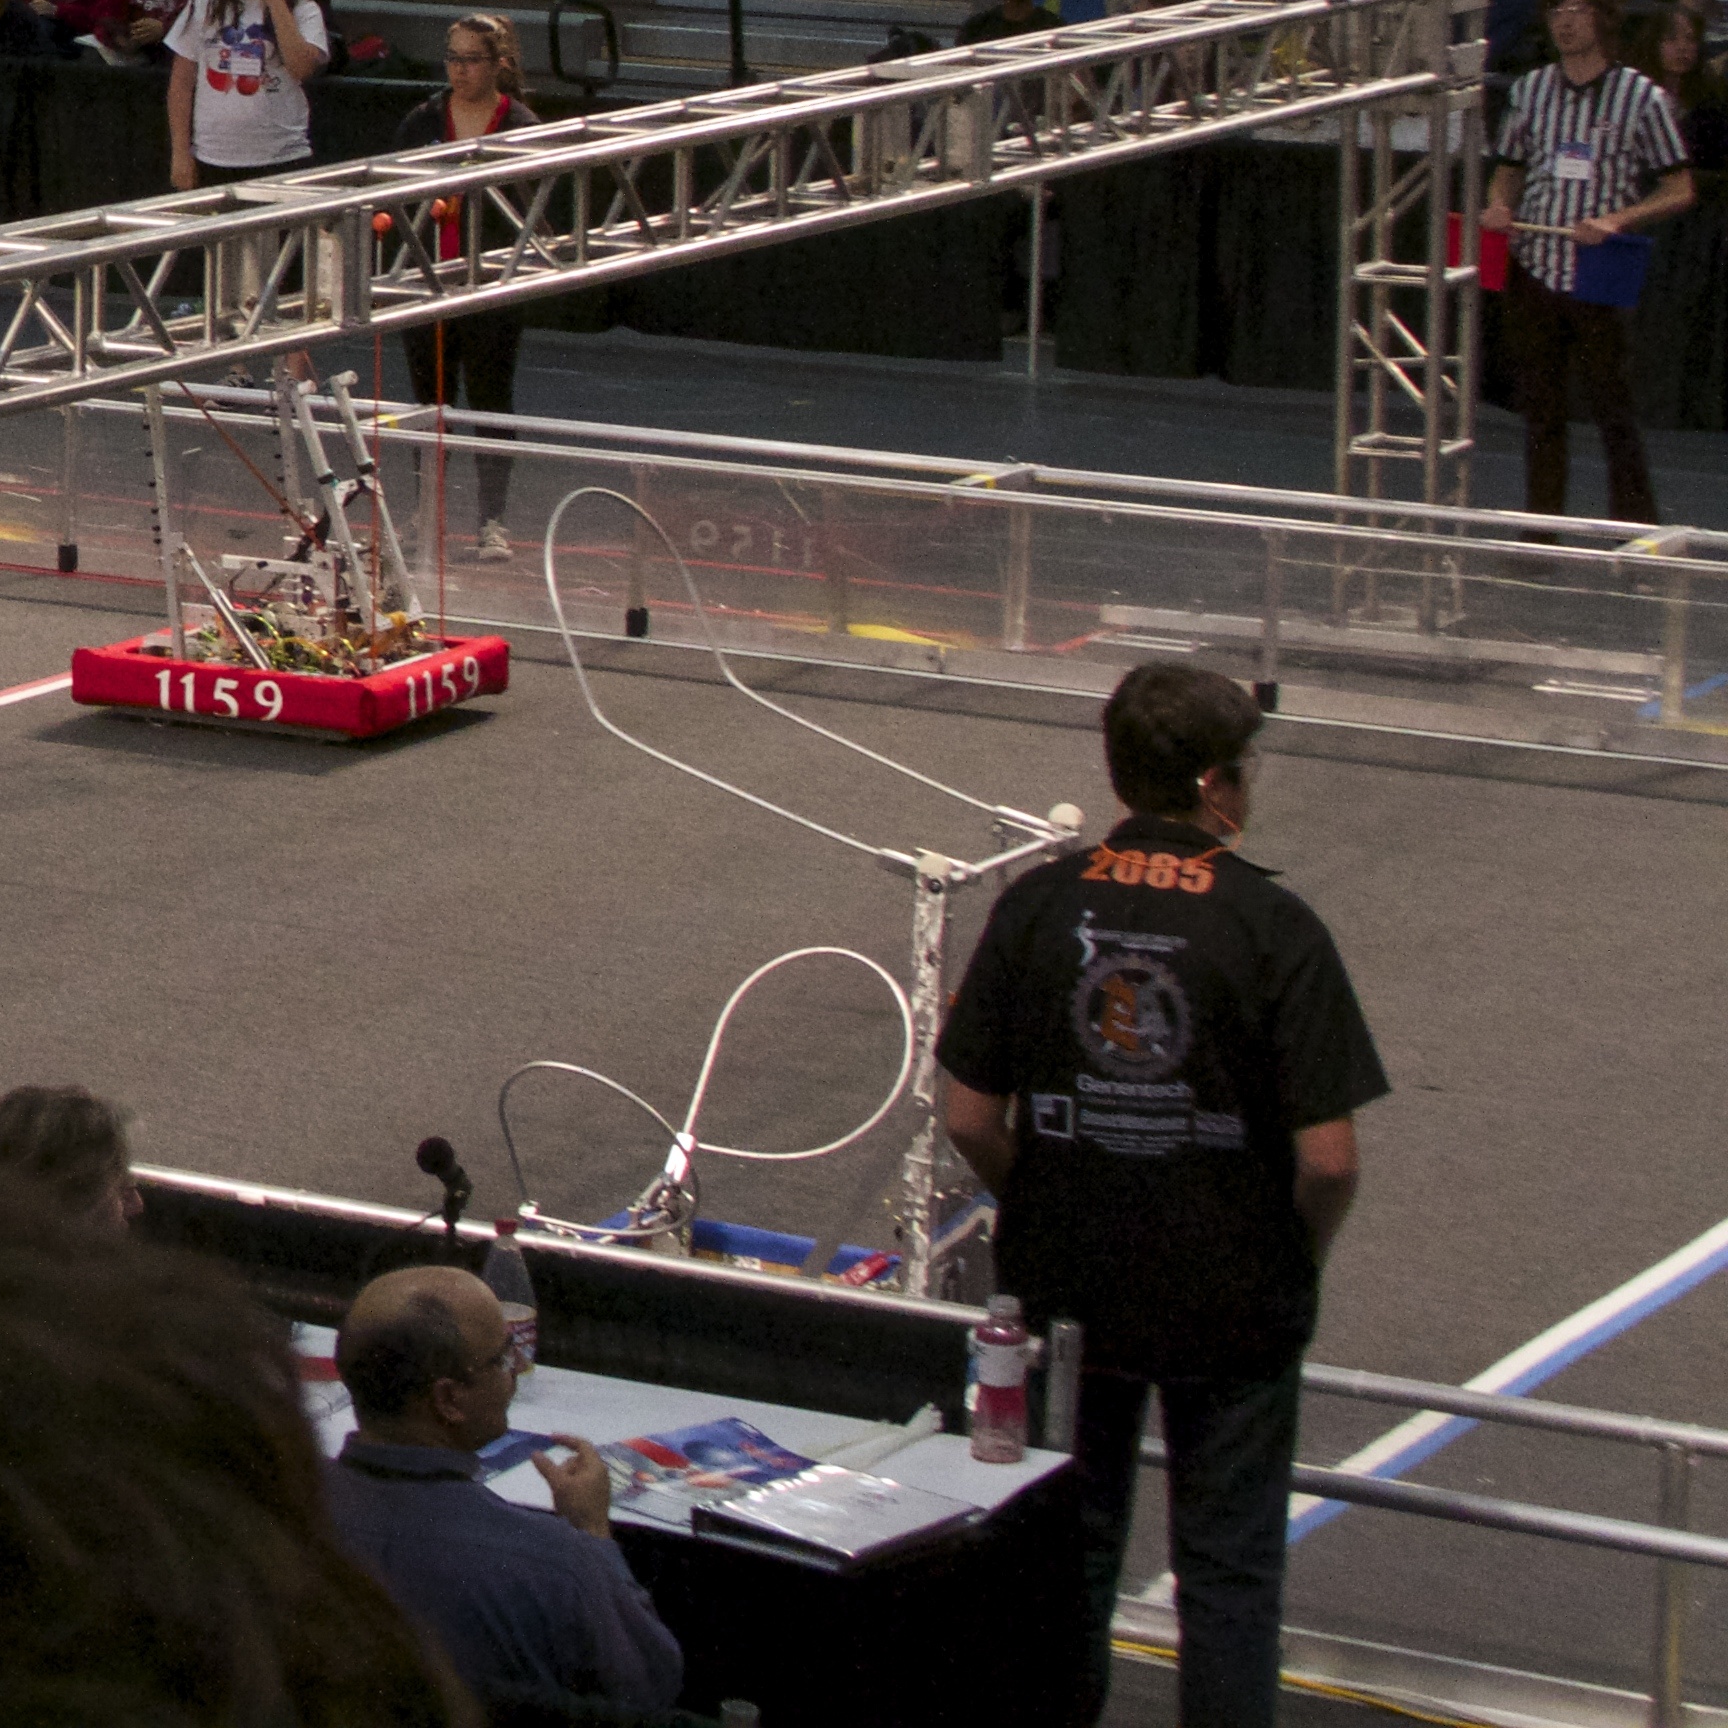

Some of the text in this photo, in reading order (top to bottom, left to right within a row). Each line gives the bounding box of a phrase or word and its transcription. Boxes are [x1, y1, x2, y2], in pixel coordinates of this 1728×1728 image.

[155, 669, 284, 721] 1159
[406, 656, 481, 720] 1159
[1079, 848, 1216, 895] 2085
